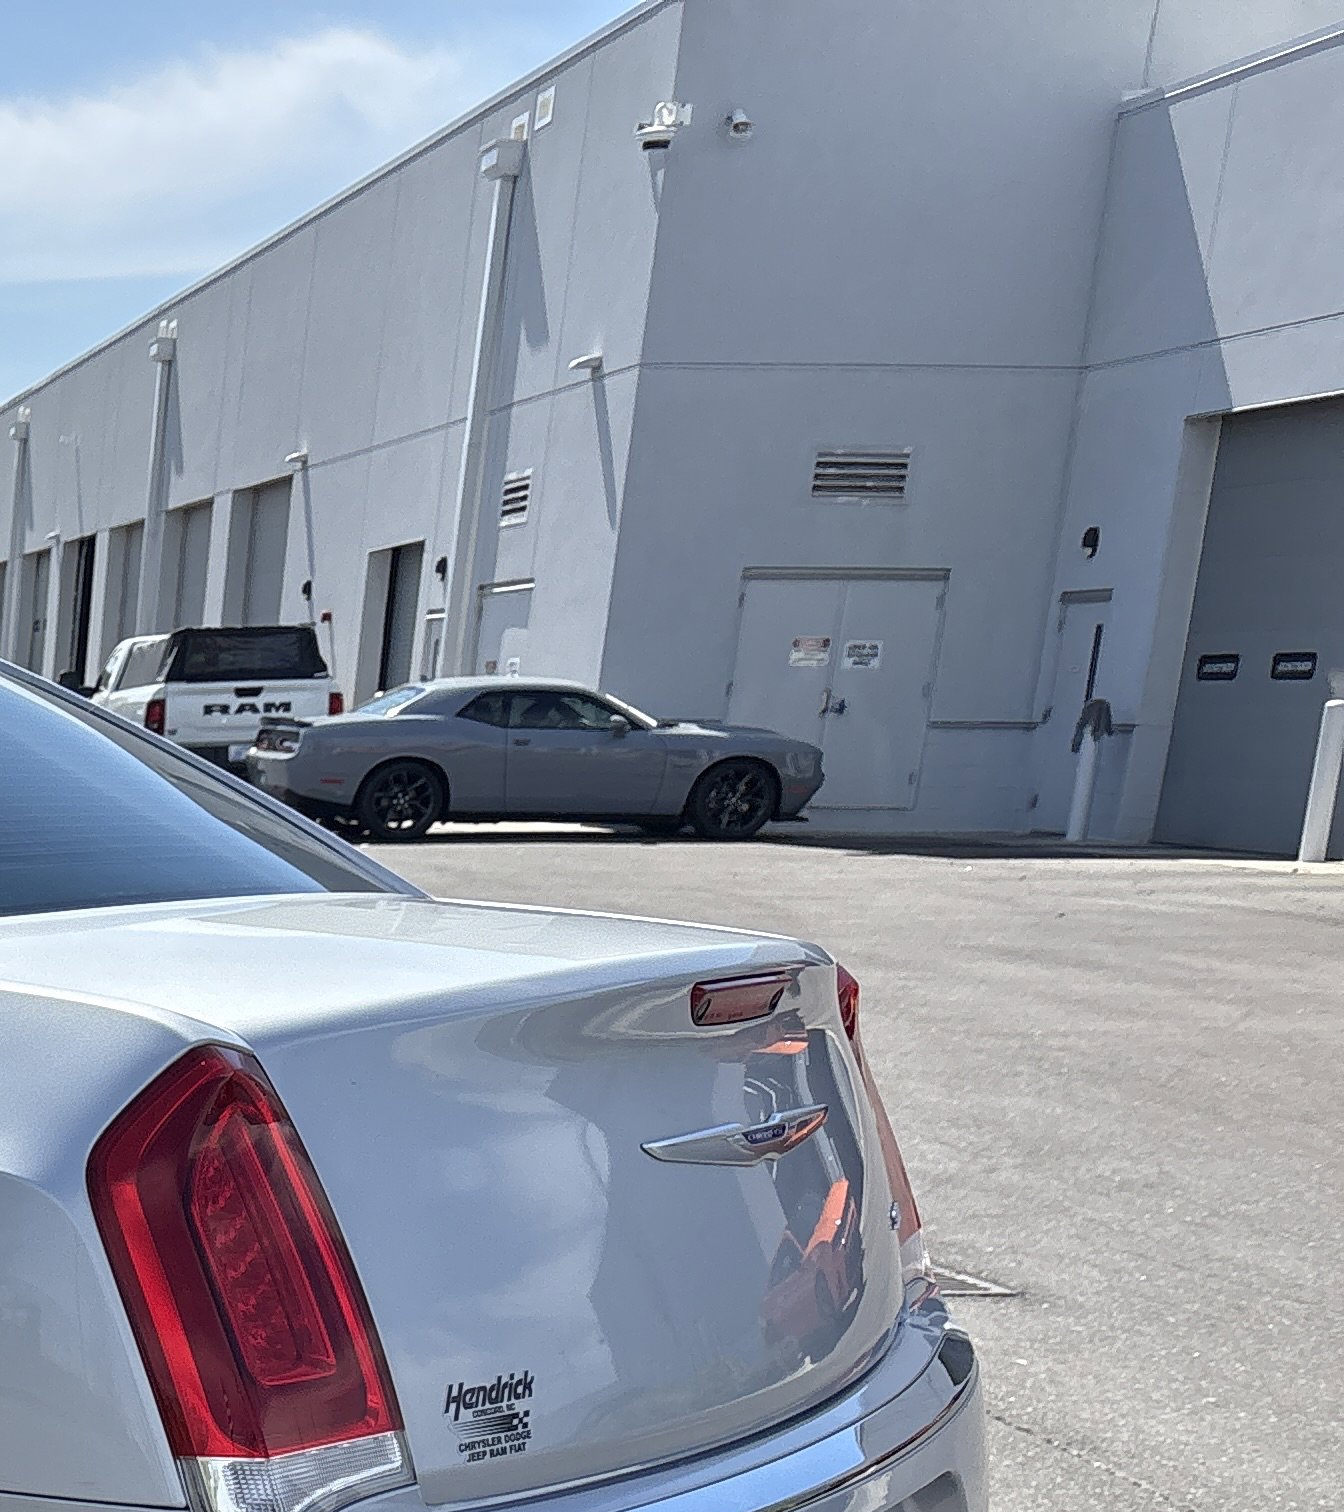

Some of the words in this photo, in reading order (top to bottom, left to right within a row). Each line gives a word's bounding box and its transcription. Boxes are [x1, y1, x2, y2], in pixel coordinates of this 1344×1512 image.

[203, 702, 292, 716] RAM
[443, 1369, 535, 1422] Hendrick
[458, 1436, 503, 1453] CHRYSLER
[504, 1430, 532, 1444] DODGE
[466, 1451, 488, 1463] JEEP
[489, 1447, 508, 1459] RAM
[509, 1442, 527, 1455] FIAT
